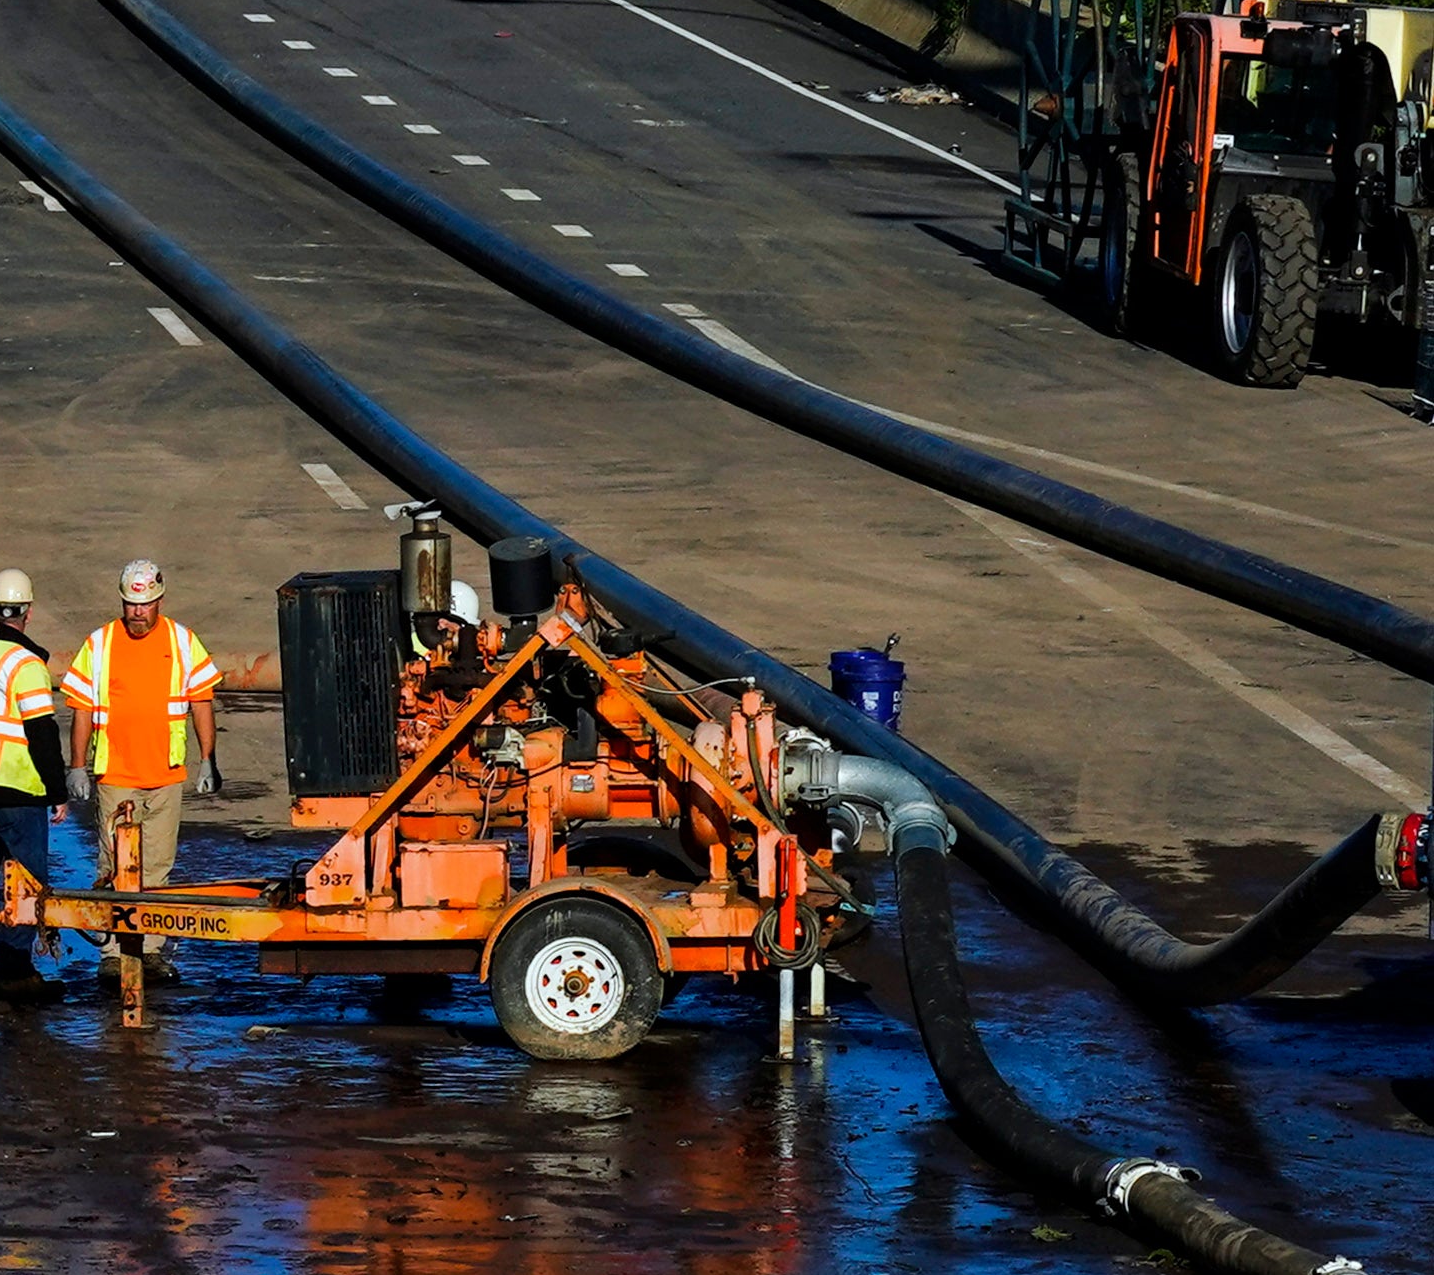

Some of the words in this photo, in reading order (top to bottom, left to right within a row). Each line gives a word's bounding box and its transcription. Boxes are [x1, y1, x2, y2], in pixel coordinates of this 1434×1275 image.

[319, 873, 354, 886] 937
[140, 912, 197, 933] GROUP,
[200, 917, 231, 934] INC.
